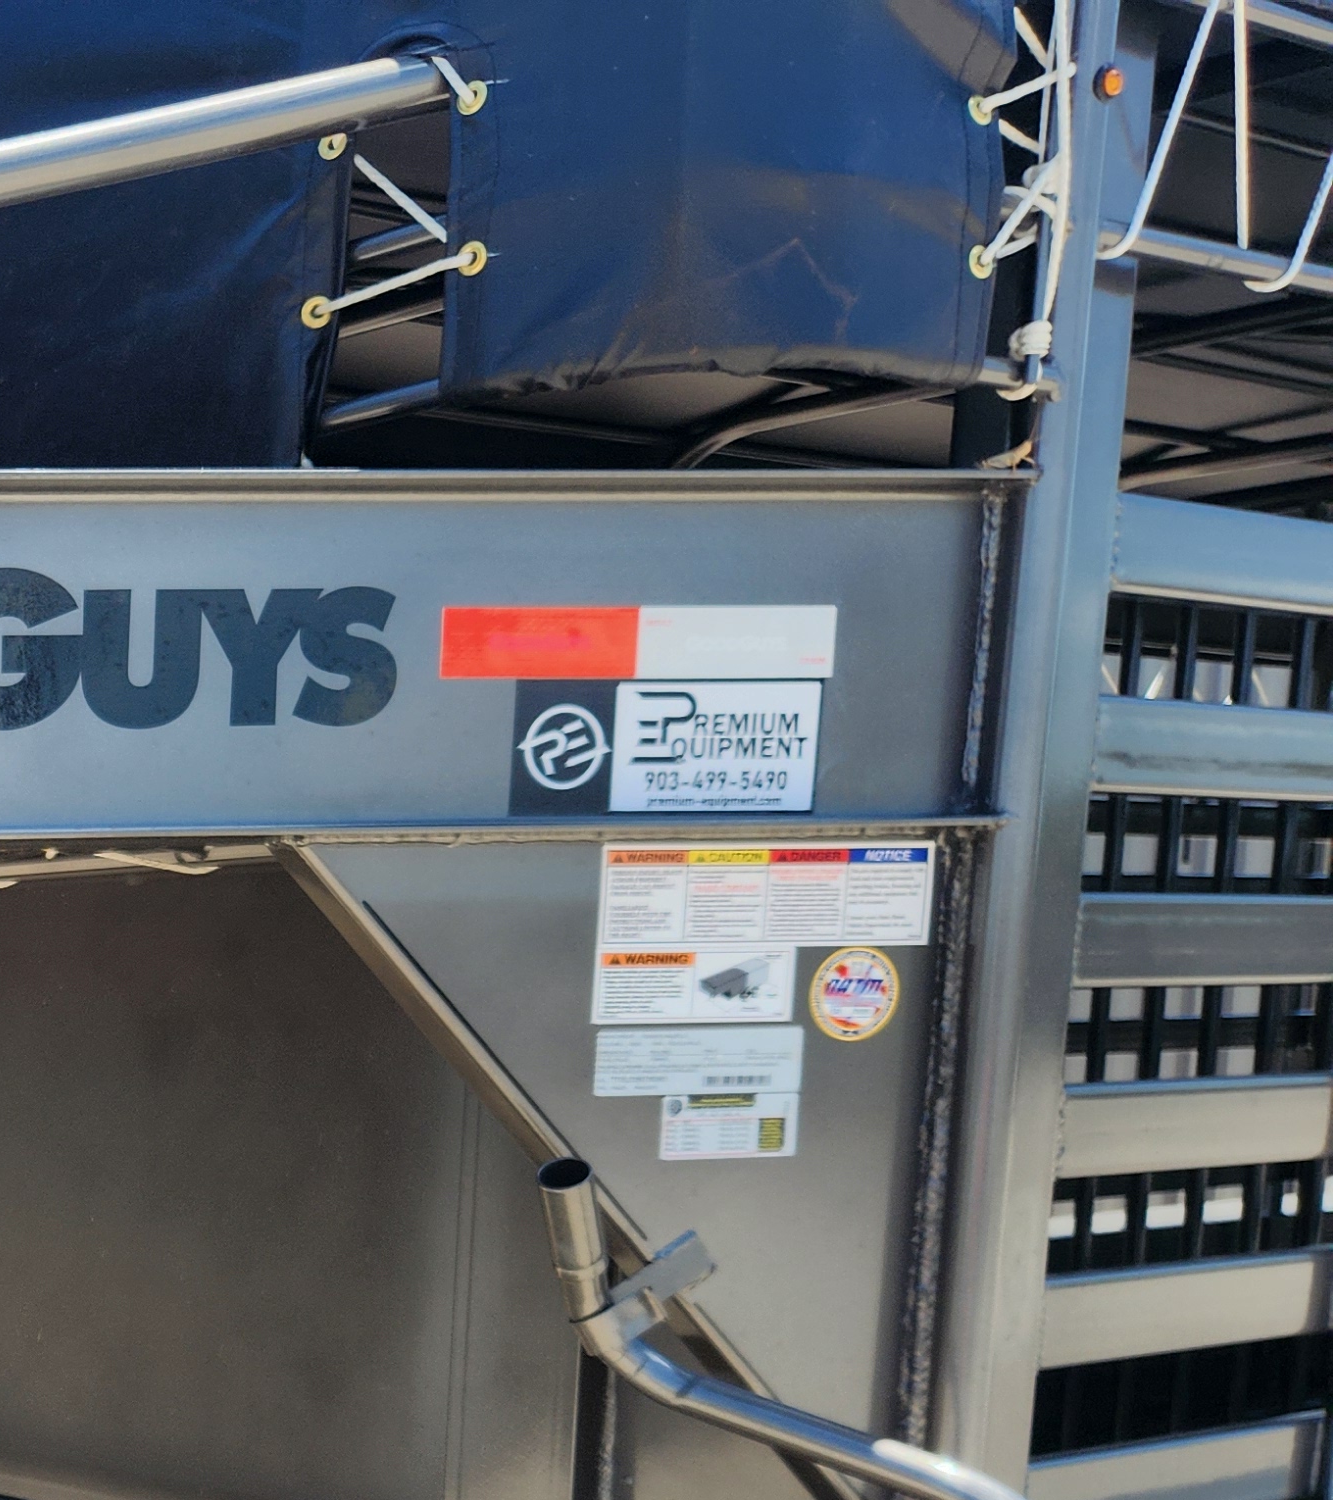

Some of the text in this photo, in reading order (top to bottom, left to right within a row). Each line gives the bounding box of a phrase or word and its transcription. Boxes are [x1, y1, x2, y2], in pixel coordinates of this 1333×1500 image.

[644, 771, 788, 790] 903-499-5490
[627, 852, 685, 863] WARNING
[709, 852, 763, 862] CAUTION
[791, 851, 842, 862] DANGER
[864, 849, 913, 861] NOTICE
[625, 954, 689, 966] WARNING
